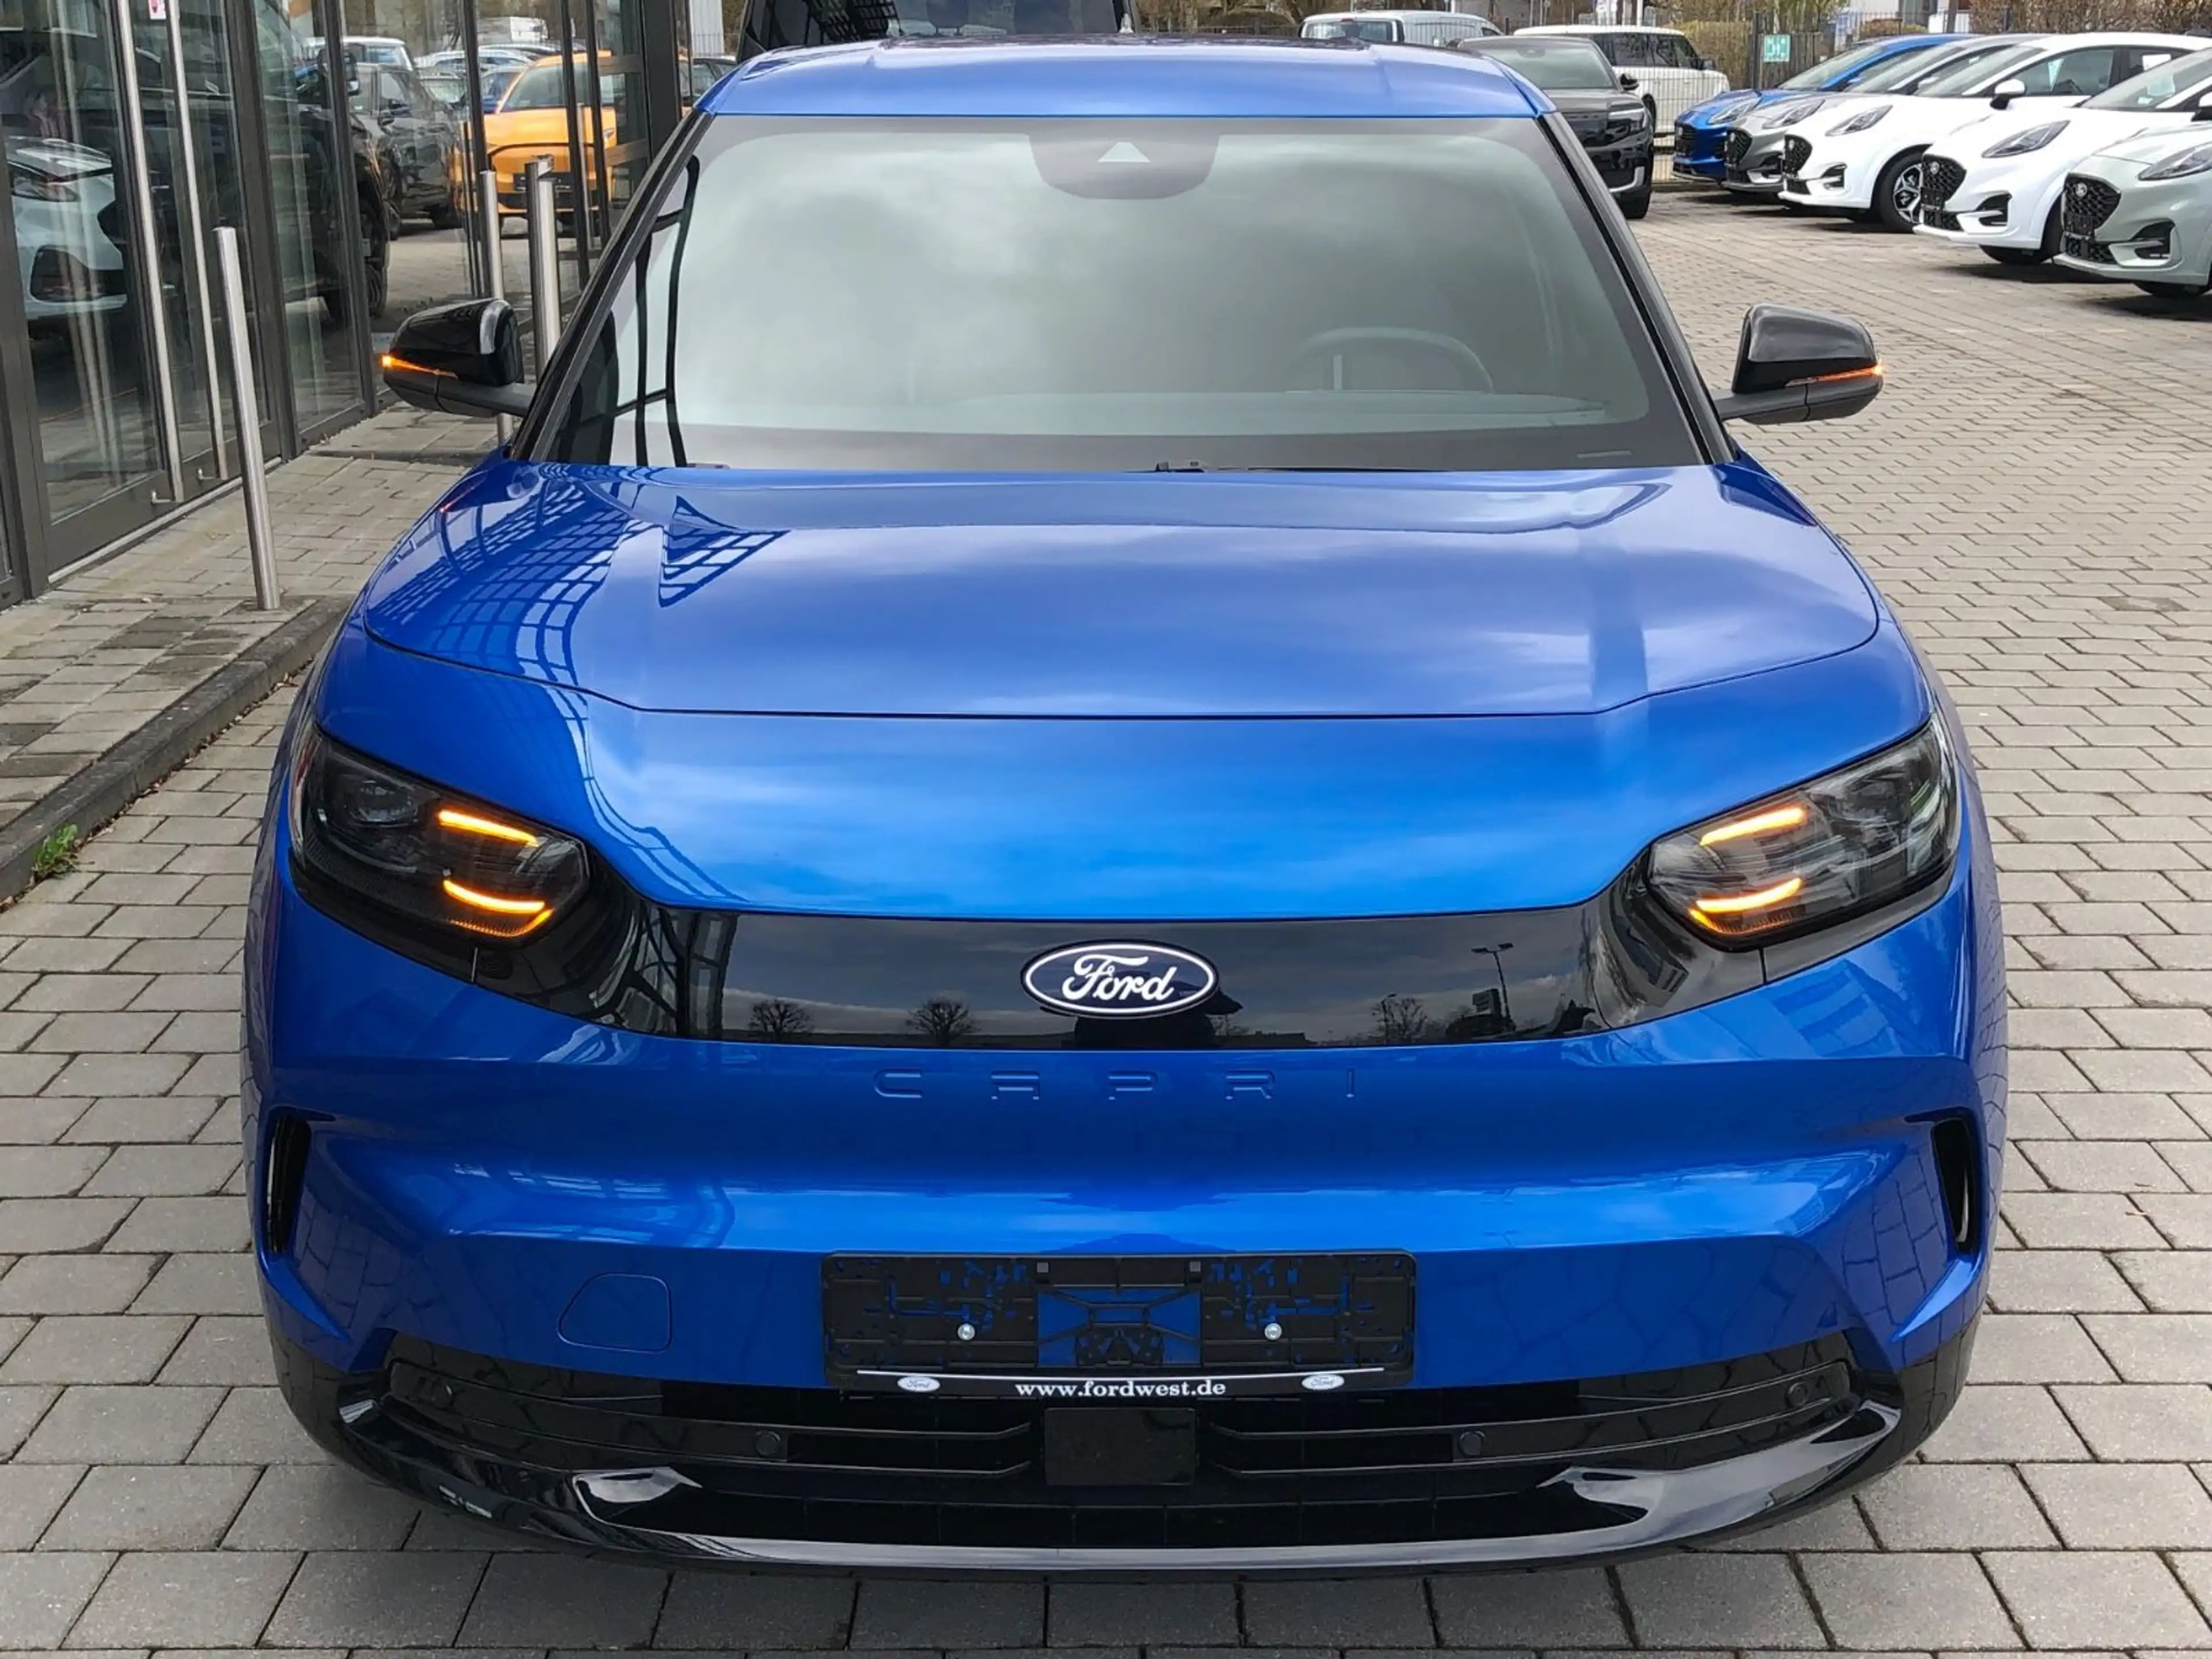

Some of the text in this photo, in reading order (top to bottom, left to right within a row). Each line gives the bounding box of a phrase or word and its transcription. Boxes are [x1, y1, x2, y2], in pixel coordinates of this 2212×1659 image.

[1062, 954, 1177, 1001] Ford
[874, 1067, 1354, 1100] CAPRI
[1015, 1380, 1226, 1397] www.fordwest.de
